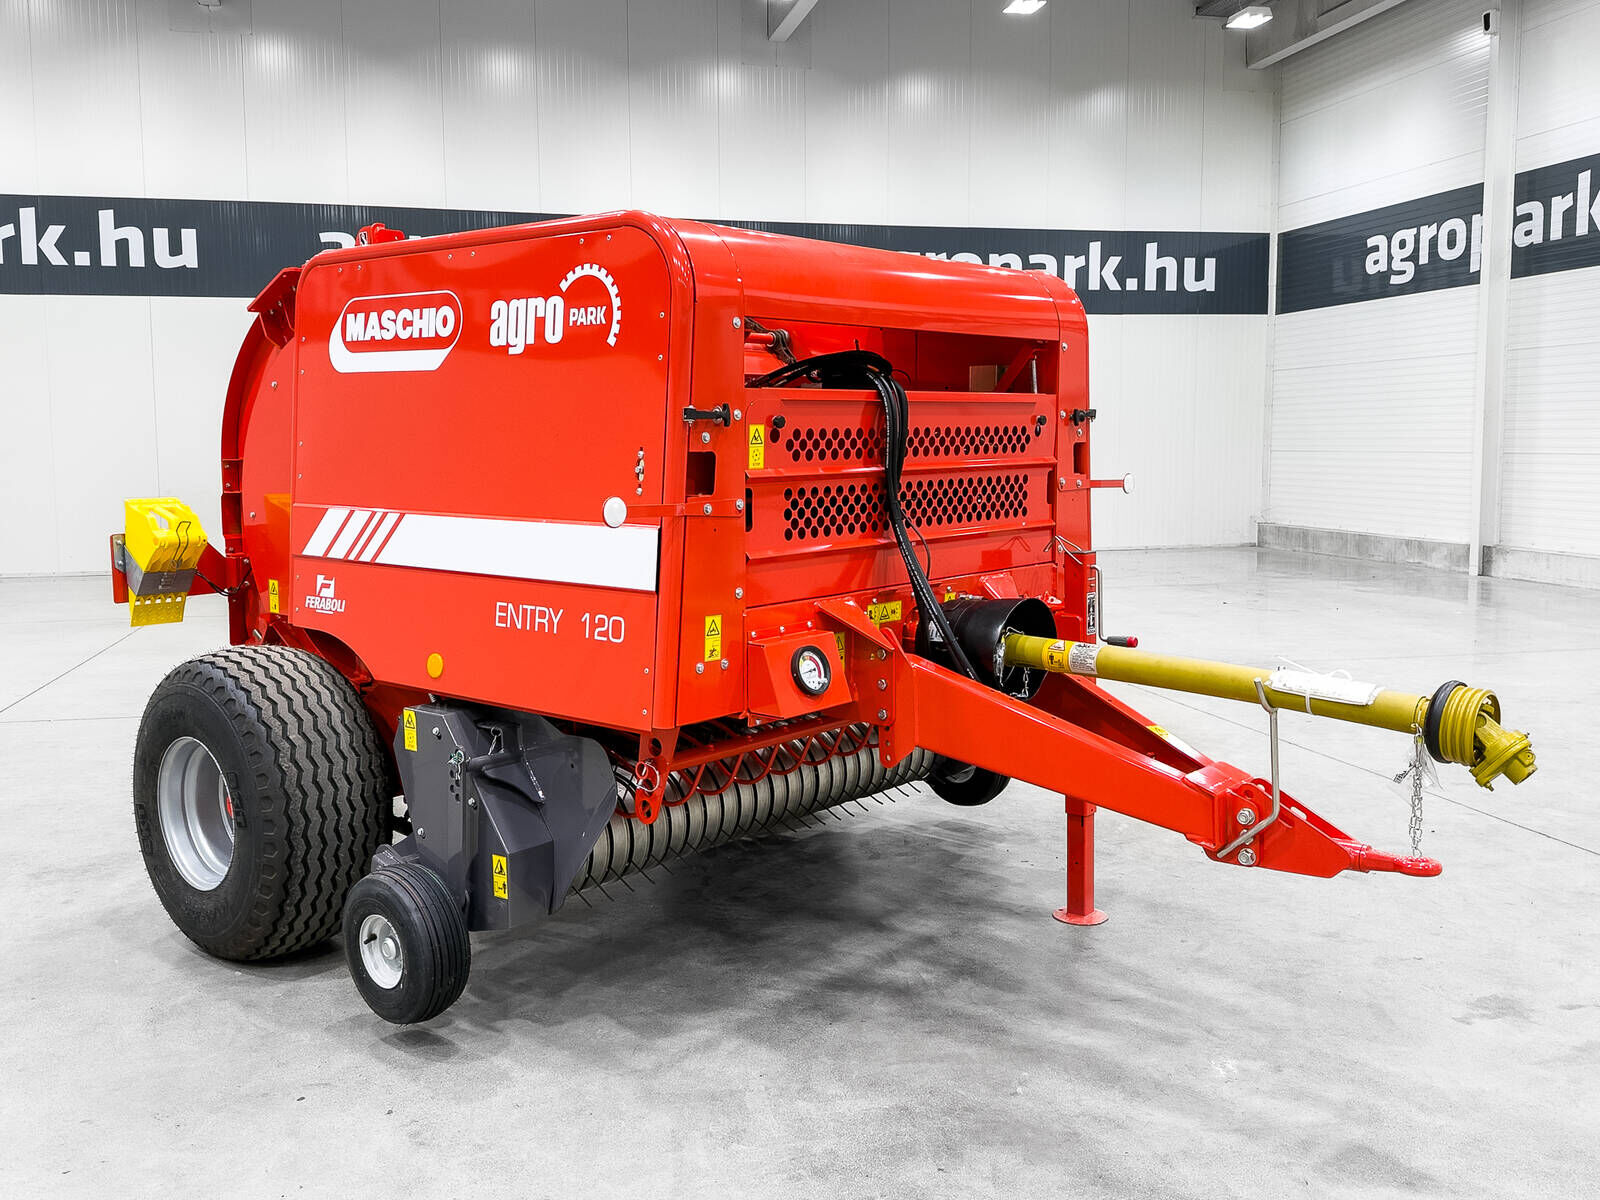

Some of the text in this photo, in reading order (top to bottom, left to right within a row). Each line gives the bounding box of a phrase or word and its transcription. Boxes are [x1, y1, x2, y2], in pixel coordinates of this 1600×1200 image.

[346, 305, 455, 342] MASCHIO
[490, 295, 606, 355] agro PARK
[305, 595, 346, 613] FERABOLI
[495, 601, 625, 643] ENTRY 120
